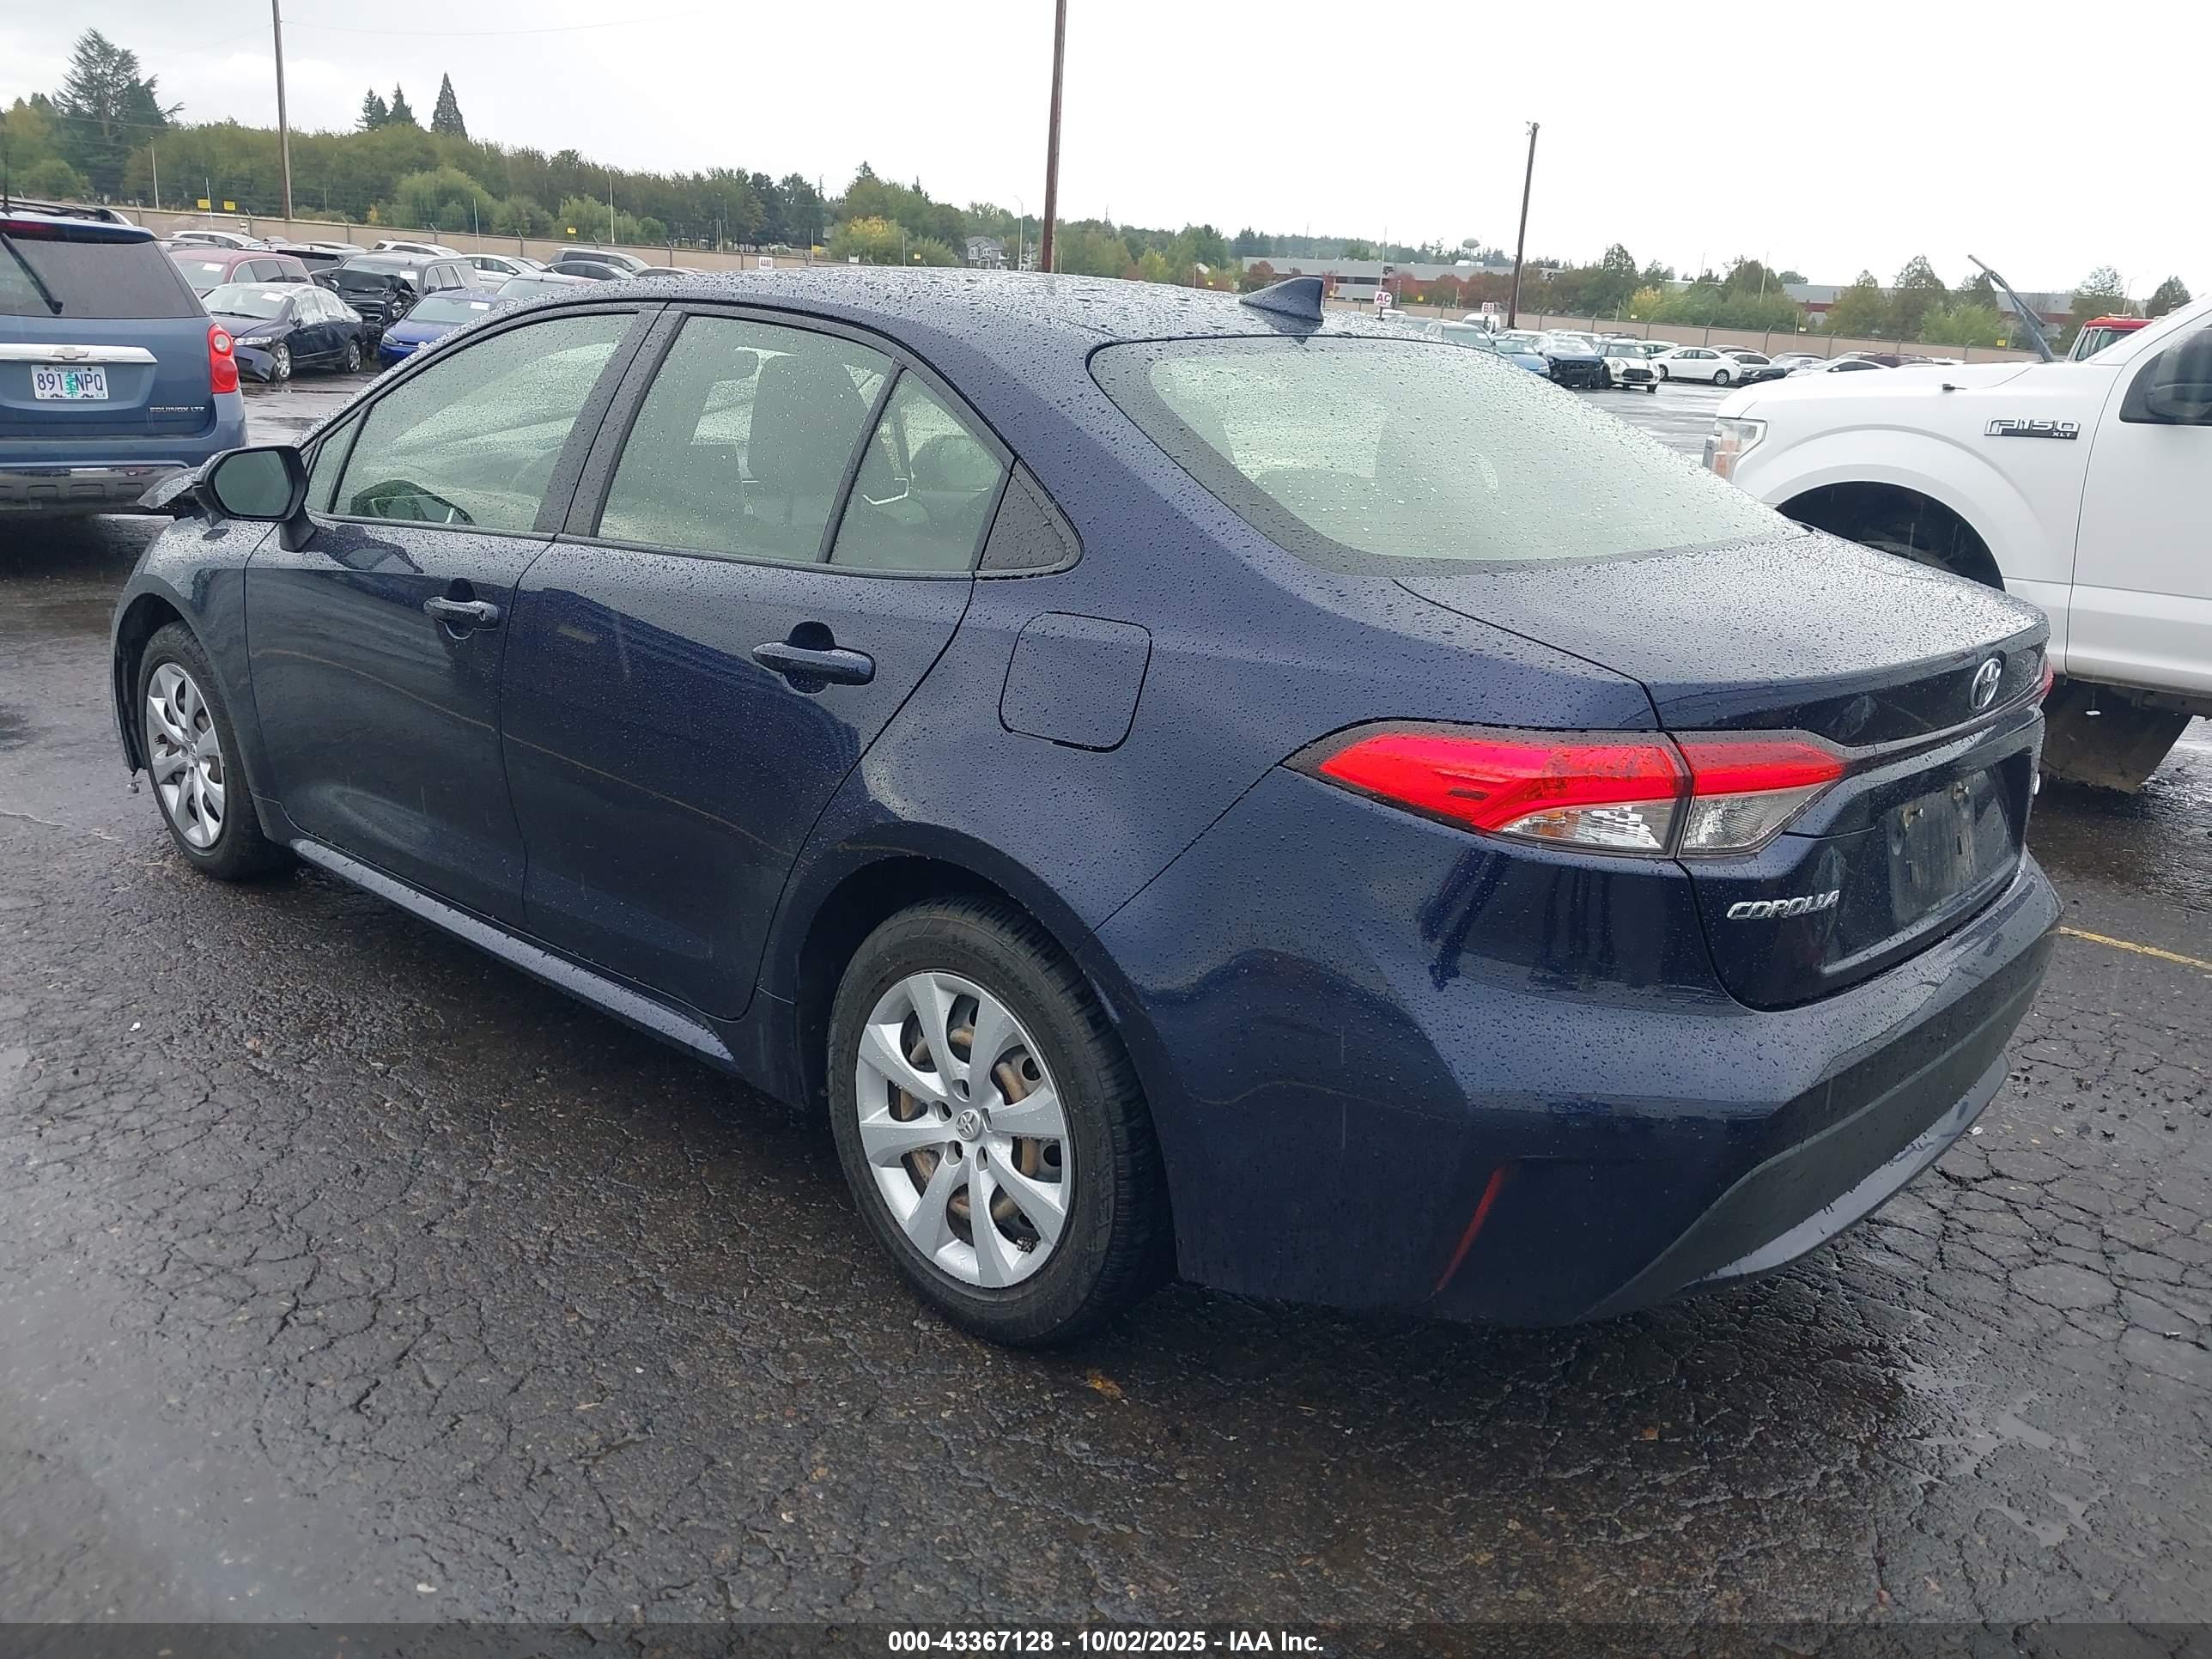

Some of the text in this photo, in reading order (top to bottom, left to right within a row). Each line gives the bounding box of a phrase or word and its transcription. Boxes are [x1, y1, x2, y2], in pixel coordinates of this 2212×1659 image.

[1376, 293, 1391, 303] AC
[37, 373, 104, 392] 891 NPQ
[1725, 889, 1841, 921] COROLLA
